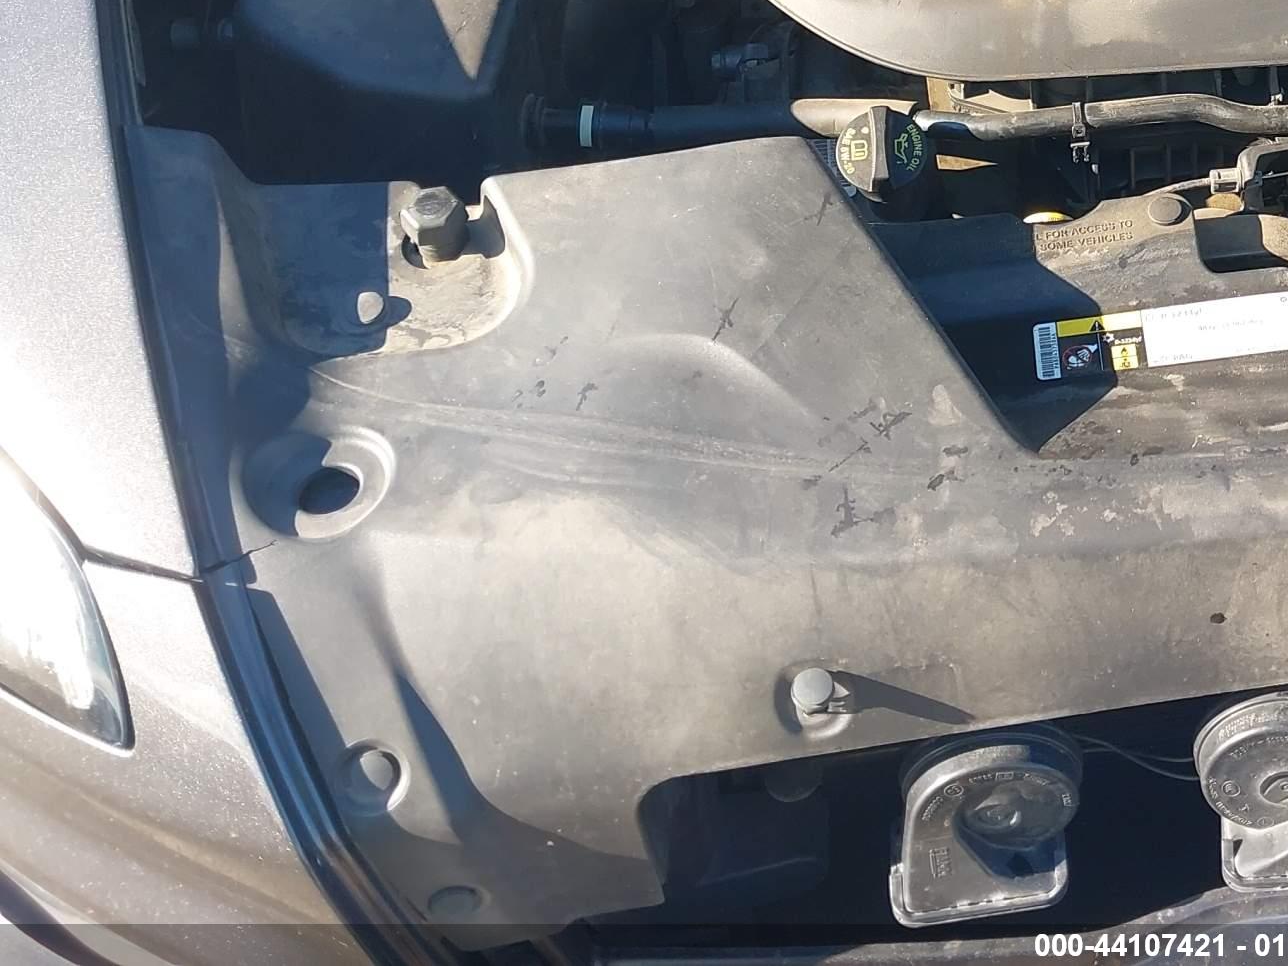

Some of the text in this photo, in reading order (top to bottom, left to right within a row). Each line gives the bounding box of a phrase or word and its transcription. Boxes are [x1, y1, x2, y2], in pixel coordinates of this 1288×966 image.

[906, 123, 923, 172] ENGINE OIL
[1046, 227, 1069, 241] FOR
[1072, 222, 1116, 236] ACCESS
[1119, 219, 1133, 229] TO
[1040, 232, 1133, 251] SOME VEHICLES
